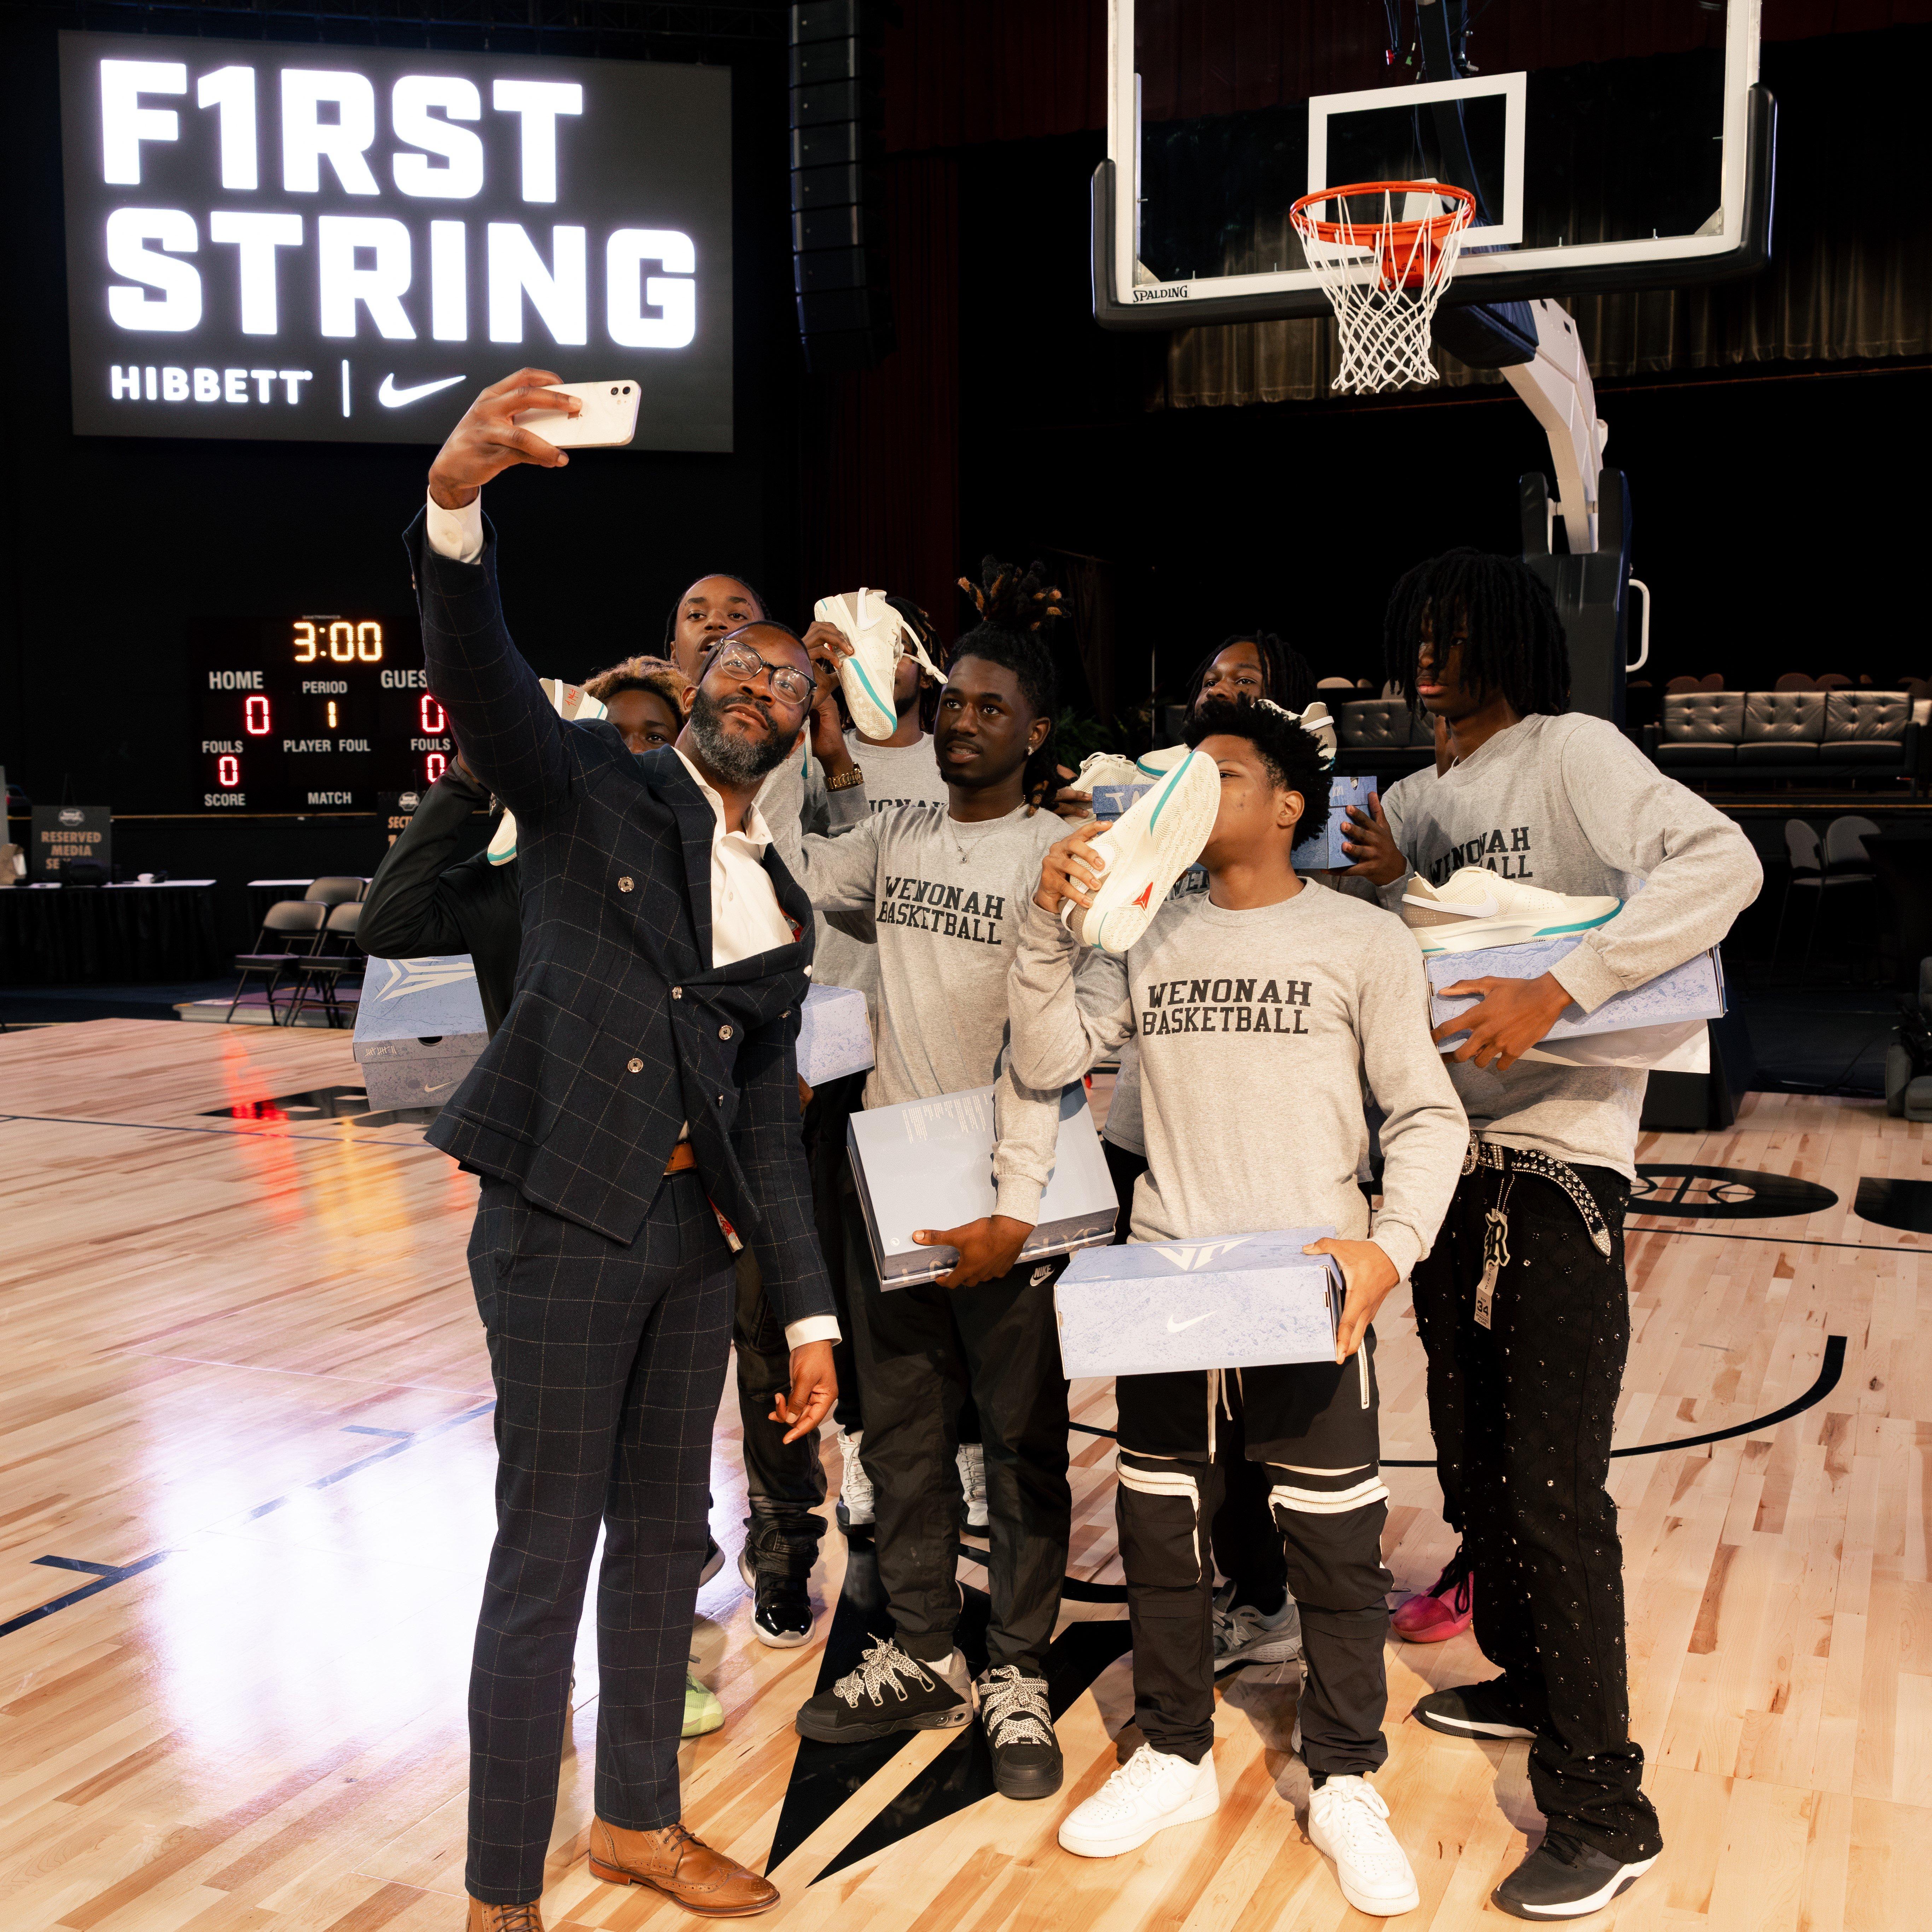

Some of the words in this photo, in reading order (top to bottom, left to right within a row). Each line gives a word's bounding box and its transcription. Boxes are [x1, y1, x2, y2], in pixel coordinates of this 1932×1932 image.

[100, 59, 582, 203] F1RST
[106, 206, 696, 349] STRING
[1133, 285, 1188, 302] SPALDING
[111, 365, 313, 406] HIBBETT
[293, 622, 382, 662] 3:00
[209, 671, 264, 689] HOME
[302, 681, 348, 693] PERIOD
[380, 670, 427, 688] GUES
[246, 696, 269, 734] 0
[328, 701, 336, 728] 1
[421, 694, 444, 732] 0
[202, 741, 243, 753] FOULS
[283, 740, 331, 752] PLAYER
[339, 739, 371, 752] FOUL
[411, 738, 451, 751] FOULS
[219, 756, 238, 786] 0
[427, 753, 445, 783] 0
[205, 794, 245, 806] SCORE
[308, 792, 351, 804] MATCH
[41, 832, 102, 843] RESERVED
[51, 845, 92, 856] MEDIA
[885, 876, 1005, 920] WENONAH
[876, 901, 1002, 945] BASKETBALL
[1148, 979, 1312, 1008] WENONAH
[1142, 1007, 1309, 1036] BASKETBALL
[1034, 1264, 1052, 1278] NIKE
[1477, 1300, 1489, 1317] 34
